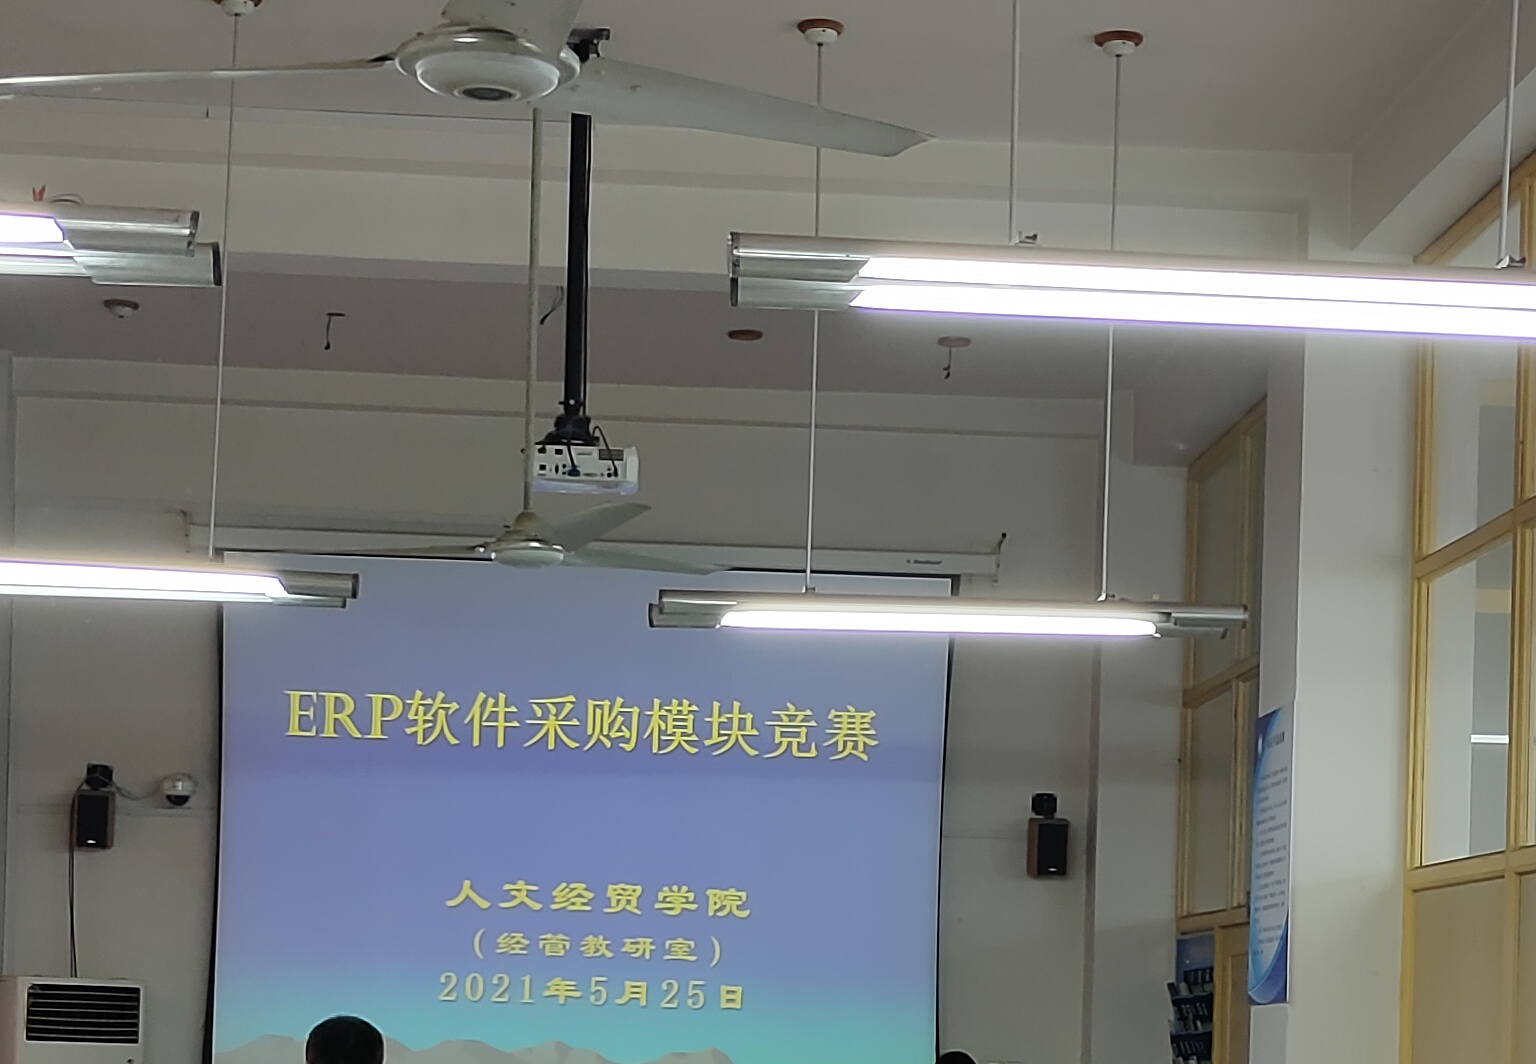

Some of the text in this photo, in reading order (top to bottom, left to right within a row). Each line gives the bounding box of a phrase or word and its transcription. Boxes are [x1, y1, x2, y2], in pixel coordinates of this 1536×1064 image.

[283, 689, 880, 762] ERP软件采购模块竞赛
[445, 879, 751, 918] 人文经贸学院
[438, 971, 743, 1010] 2021年5月25日
